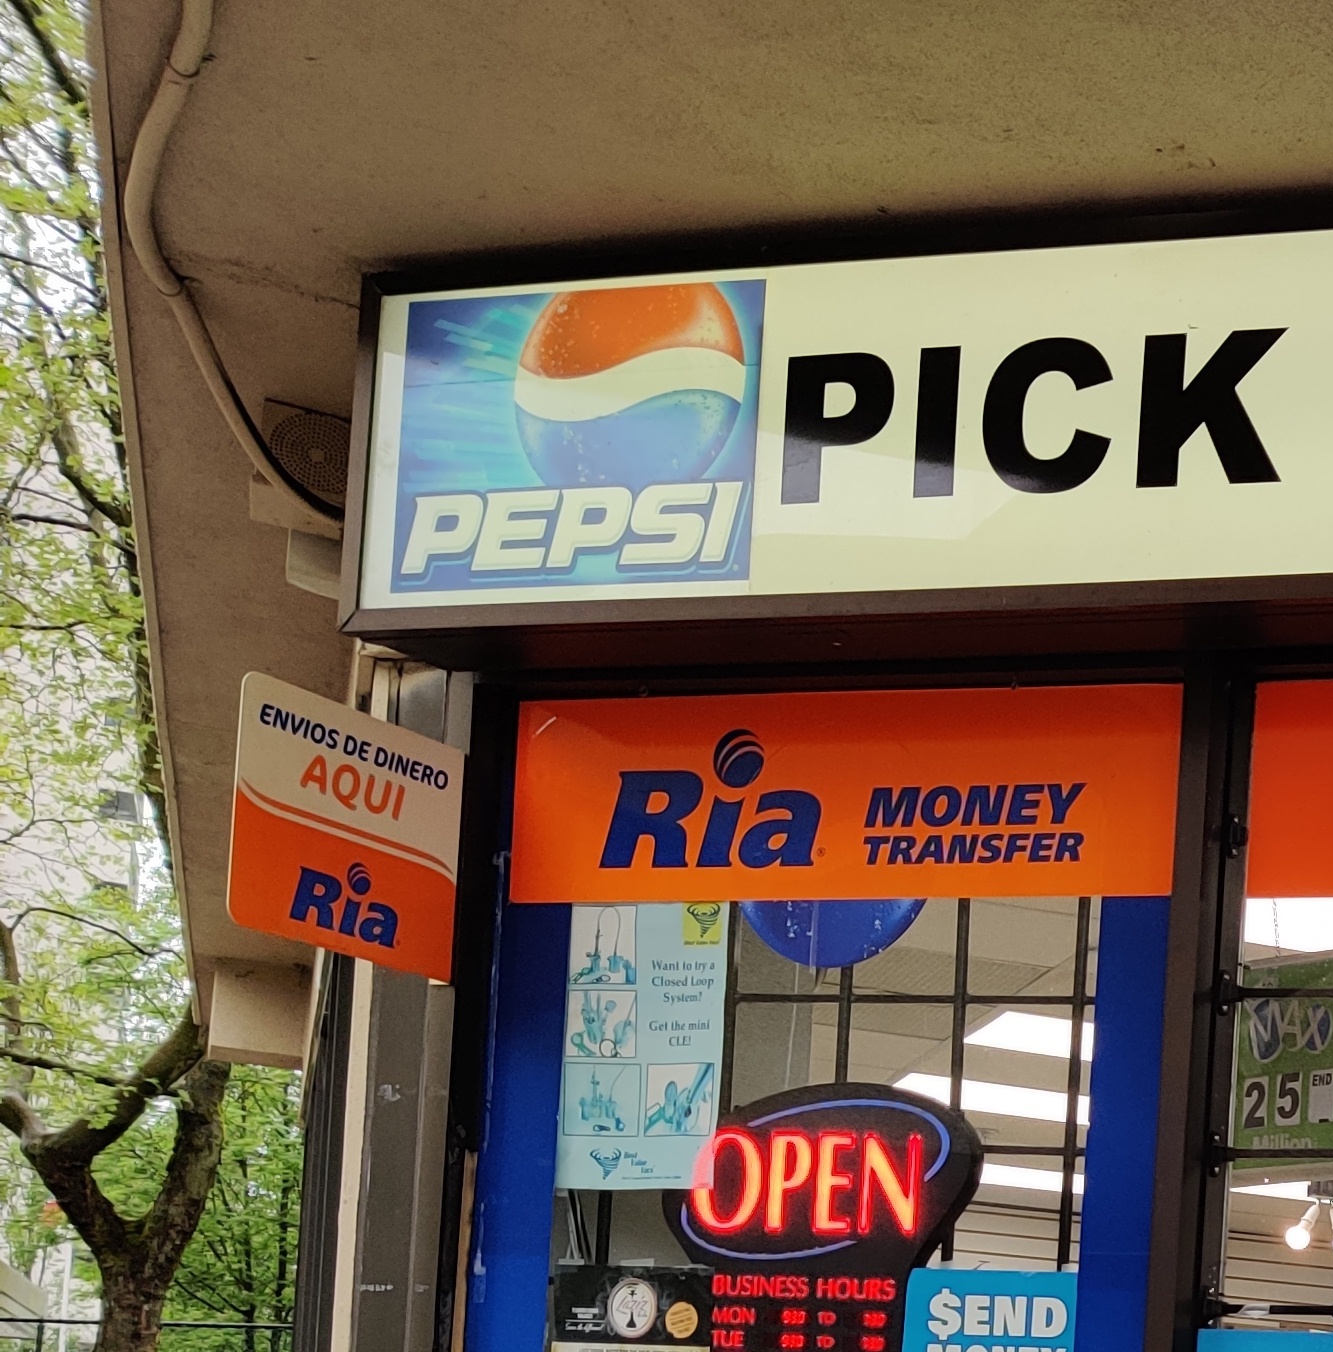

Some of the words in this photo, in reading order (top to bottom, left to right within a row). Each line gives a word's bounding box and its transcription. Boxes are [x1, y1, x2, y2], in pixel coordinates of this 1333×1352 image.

[780, 327, 1289, 505] PICK
[402, 483, 744, 577] PEPSI
[260, 703, 340, 753] ENVIOS
[344, 737, 369, 763] DE
[373, 744, 448, 791] DINERO
[300, 754, 405, 823] AQUI
[598, 729, 823, 868] Ria
[863, 783, 1087, 827] MONEY
[862, 832, 1084, 866] TRANSFER
[288, 862, 399, 949] Ria
[652, 960, 679, 971] Want
[682, 961, 692, 971] to
[694, 961, 708, 973] try
[652, 976, 688, 987] Closed
[690, 977, 715, 989] Loop
[663, 992, 702, 1003] System?
[649, 1020, 667, 1031] Get
[670, 1020, 686, 1030] the
[688, 1019, 711, 1030] mini
[1312, 1073, 1333, 1087] END
[690, 1128, 923, 1236] OPEN
[712, 1274, 809, 1297] BUSINESS
[816, 1278, 897, 1300] HOURS
[711, 1306, 756, 1325] MON
[927, 1289, 1068, 1341] $END
[711, 1331, 745, 1347] TUE
